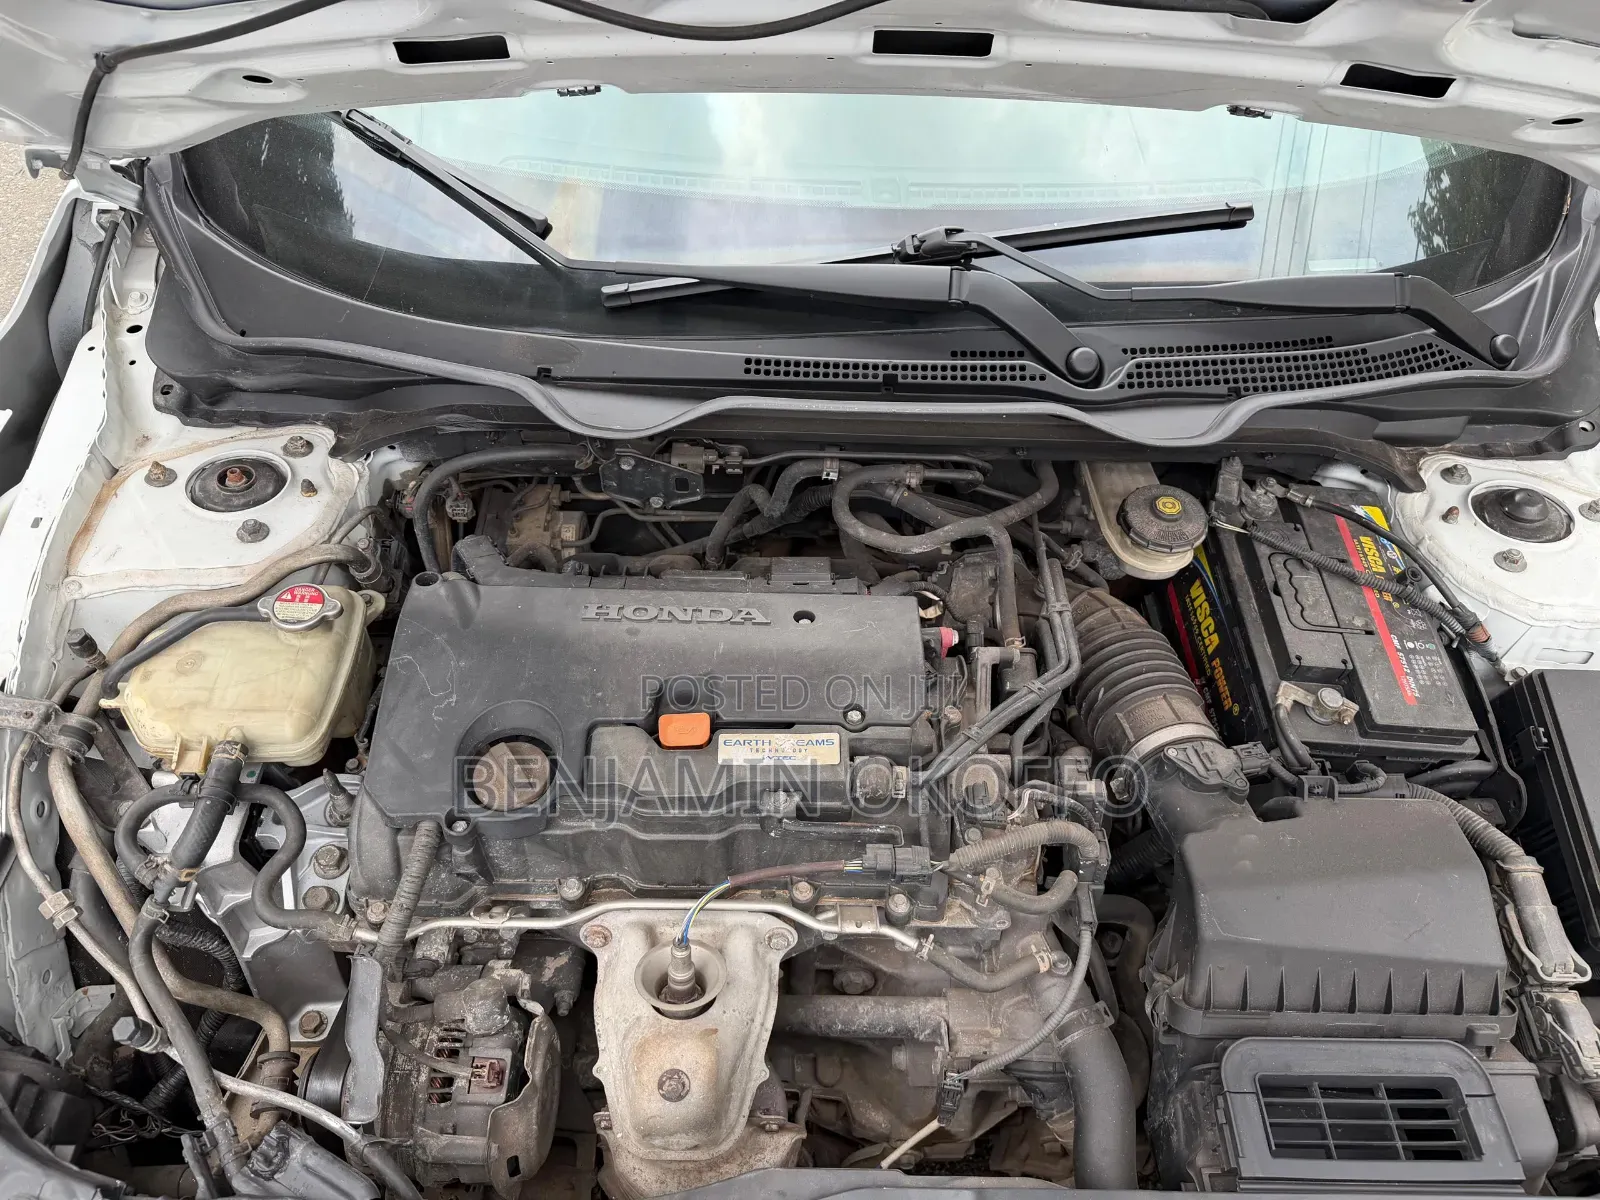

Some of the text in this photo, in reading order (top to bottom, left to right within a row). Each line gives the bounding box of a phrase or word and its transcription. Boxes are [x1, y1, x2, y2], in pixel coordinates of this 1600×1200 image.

[1359, 536, 1386, 573] VISCA
[581, 603, 771, 626] HONDA
[1189, 577, 1220, 655] VISCA
[1211, 657, 1233, 711] POWER
[723, 737, 836, 747] EARTH EAMS
